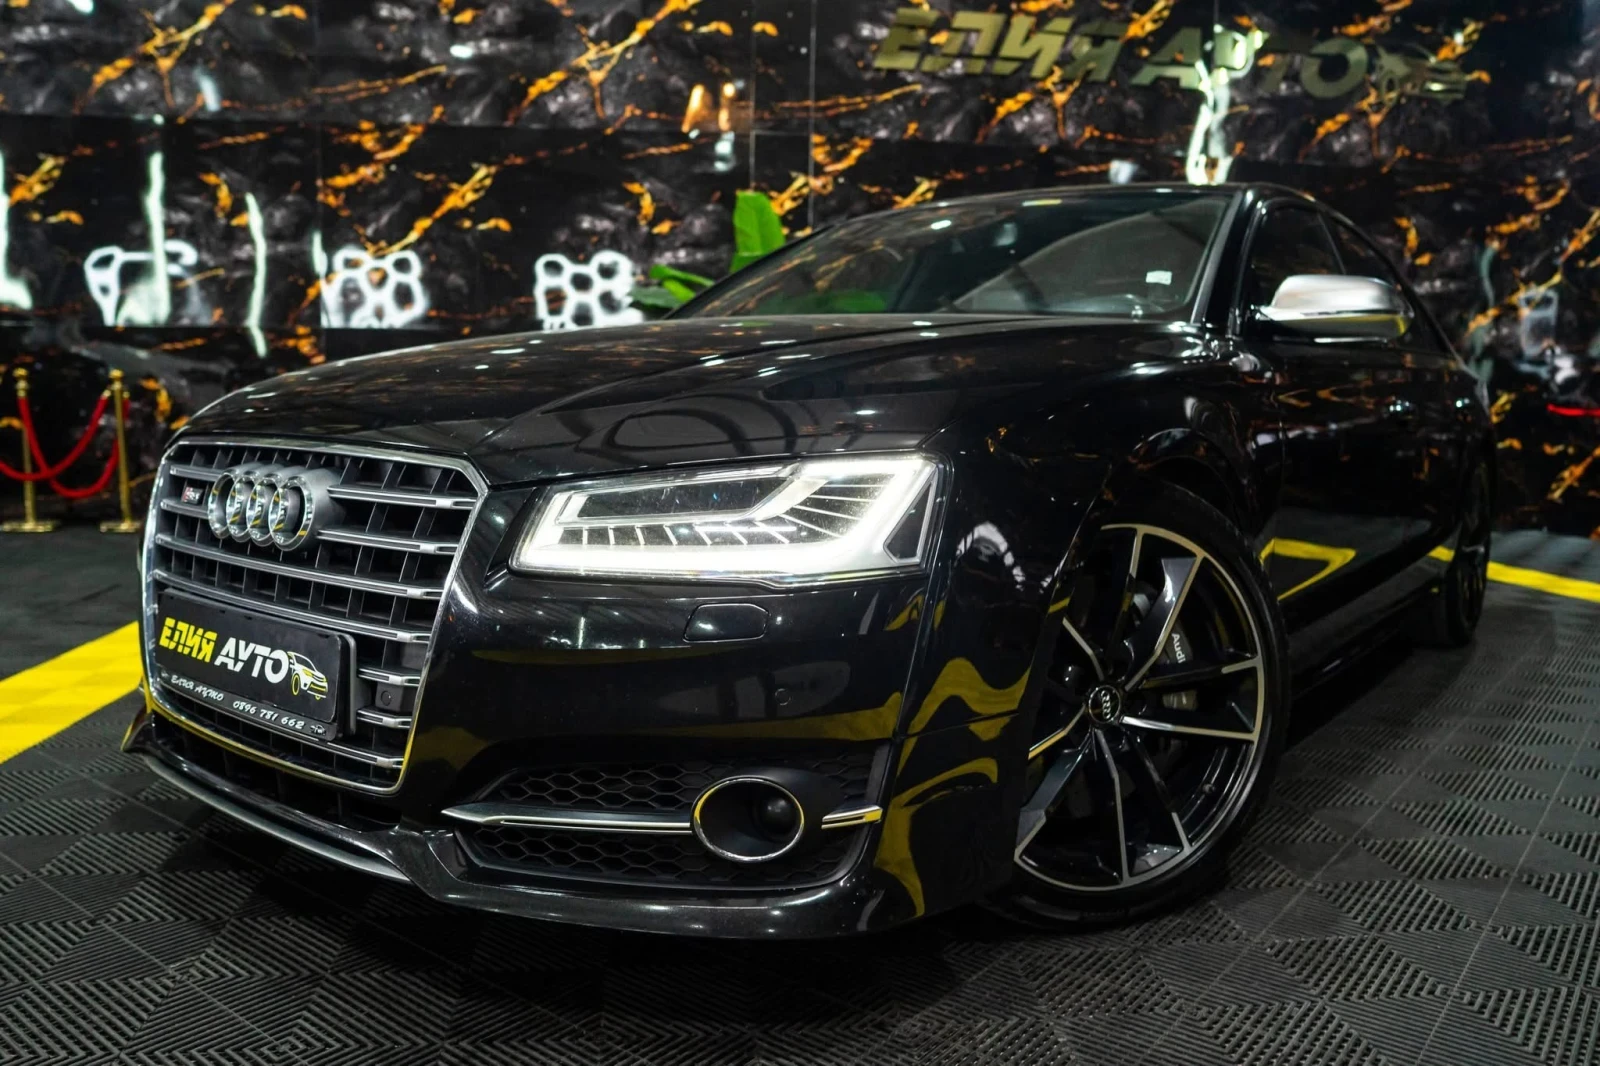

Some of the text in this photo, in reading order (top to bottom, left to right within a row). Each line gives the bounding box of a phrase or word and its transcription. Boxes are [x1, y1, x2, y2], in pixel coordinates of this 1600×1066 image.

[159, 616, 289, 684] ЕЛИЯ АУТО
[1171, 632, 1186, 664] Audi
[232, 700, 257, 714] 0896
[259, 709, 278, 722] 781
[280, 716, 306, 730] 662
